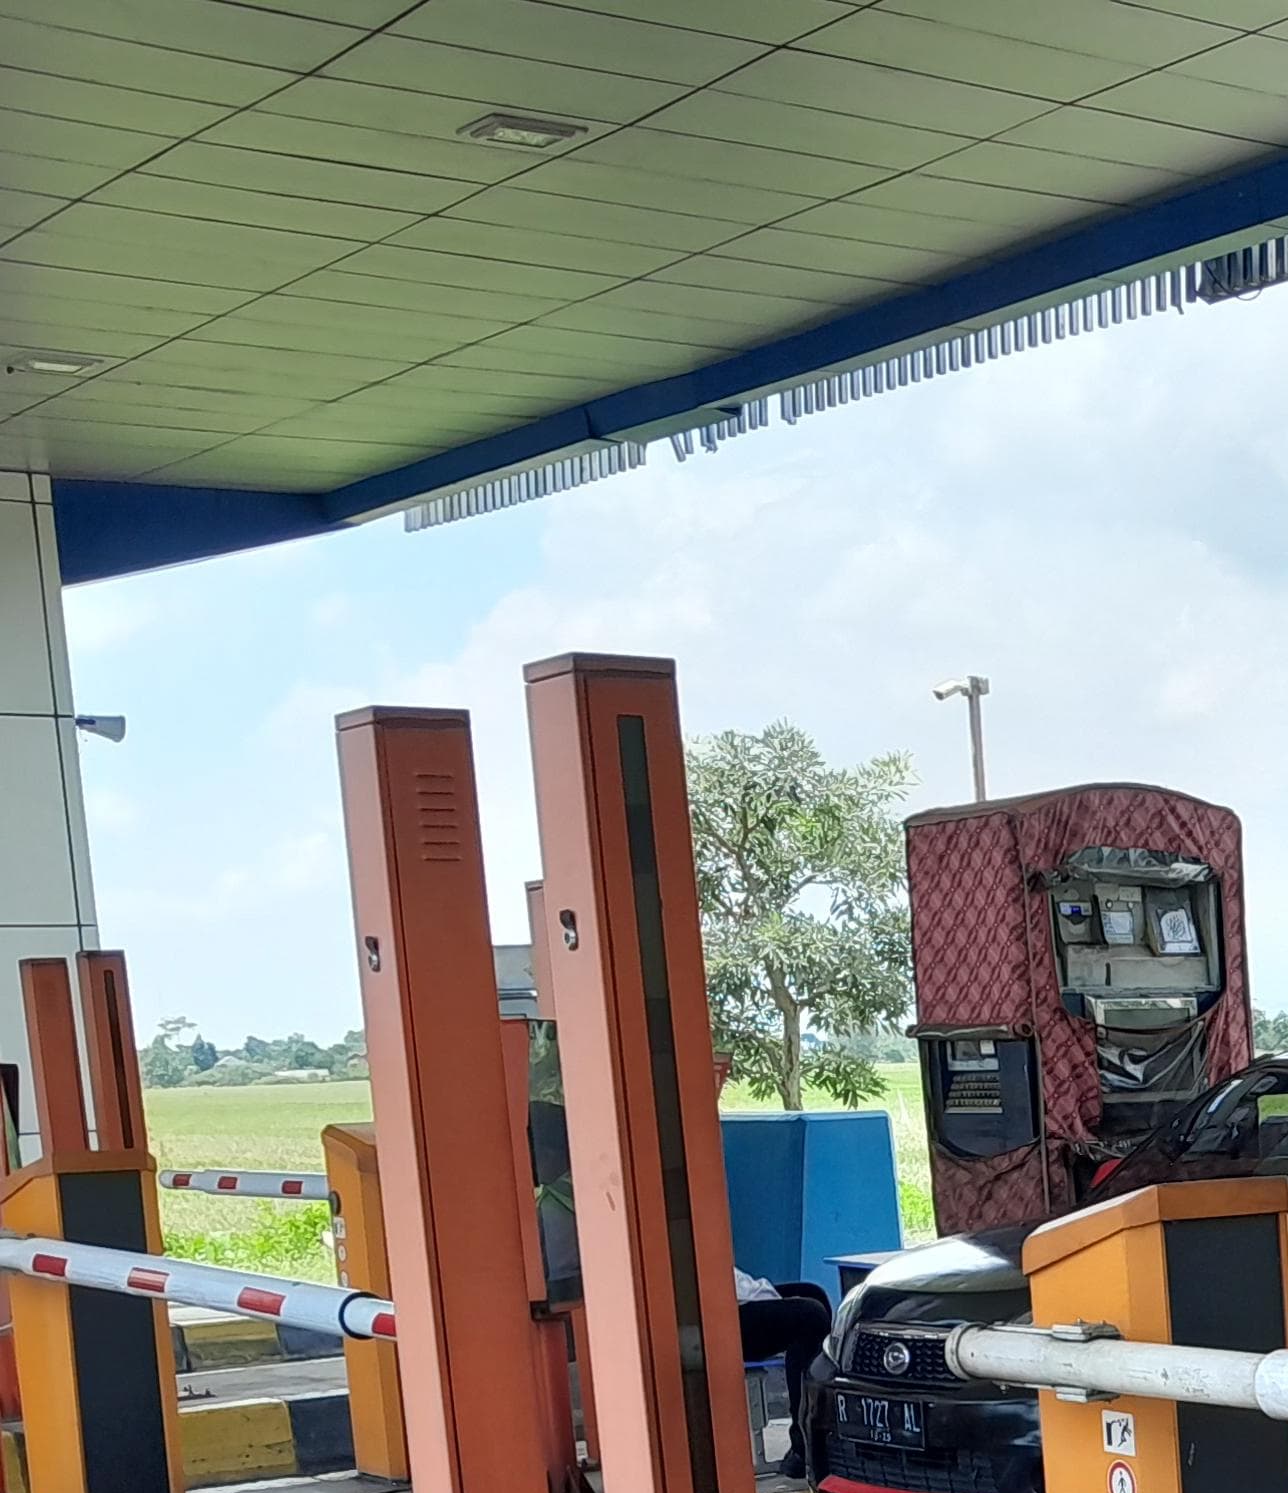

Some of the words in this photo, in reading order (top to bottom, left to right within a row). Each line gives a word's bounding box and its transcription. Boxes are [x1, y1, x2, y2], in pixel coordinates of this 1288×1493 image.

[837, 1394, 847, 1422] R
[861, 1397, 889, 1429] 1727
[904, 1402, 920, 1432] AL
